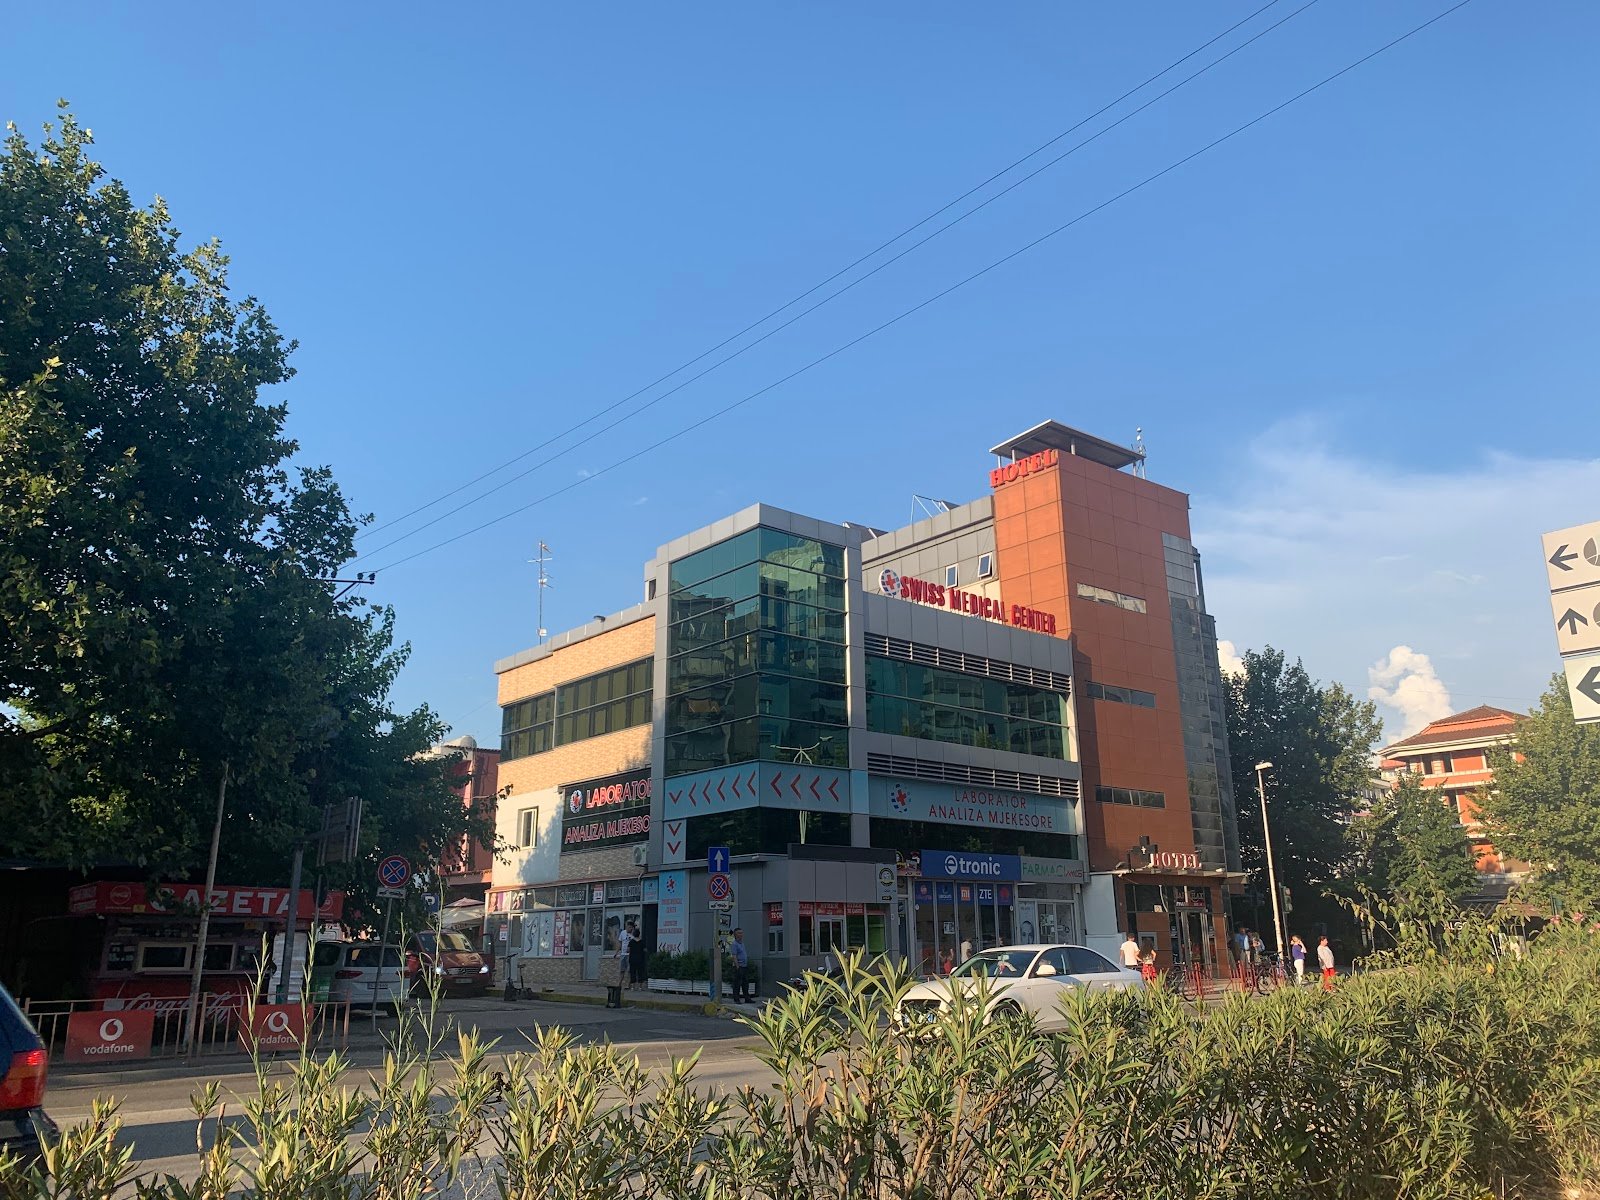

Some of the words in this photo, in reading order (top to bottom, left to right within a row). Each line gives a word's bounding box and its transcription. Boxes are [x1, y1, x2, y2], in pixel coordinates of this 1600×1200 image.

[989, 448, 1058, 488] HOTEL
[900, 575, 945, 607] SWISS
[949, 588, 1009, 623] MEDICAL
[1011, 604, 1057, 635] CENTER
[954, 788, 1027, 810] LABORATOR
[928, 804, 985, 822] ANALIZA
[988, 810, 1053, 829] MJEKESORE
[564, 822, 606, 844] ANALIZA
[1022, 861, 1066, 878] FARMACI
[1149, 852, 1202, 869] HOTEL
[979, 888, 993, 900] ZTE
[83, 1042, 135, 1056] vodafone
[255, 1034, 299, 1046] odafone
